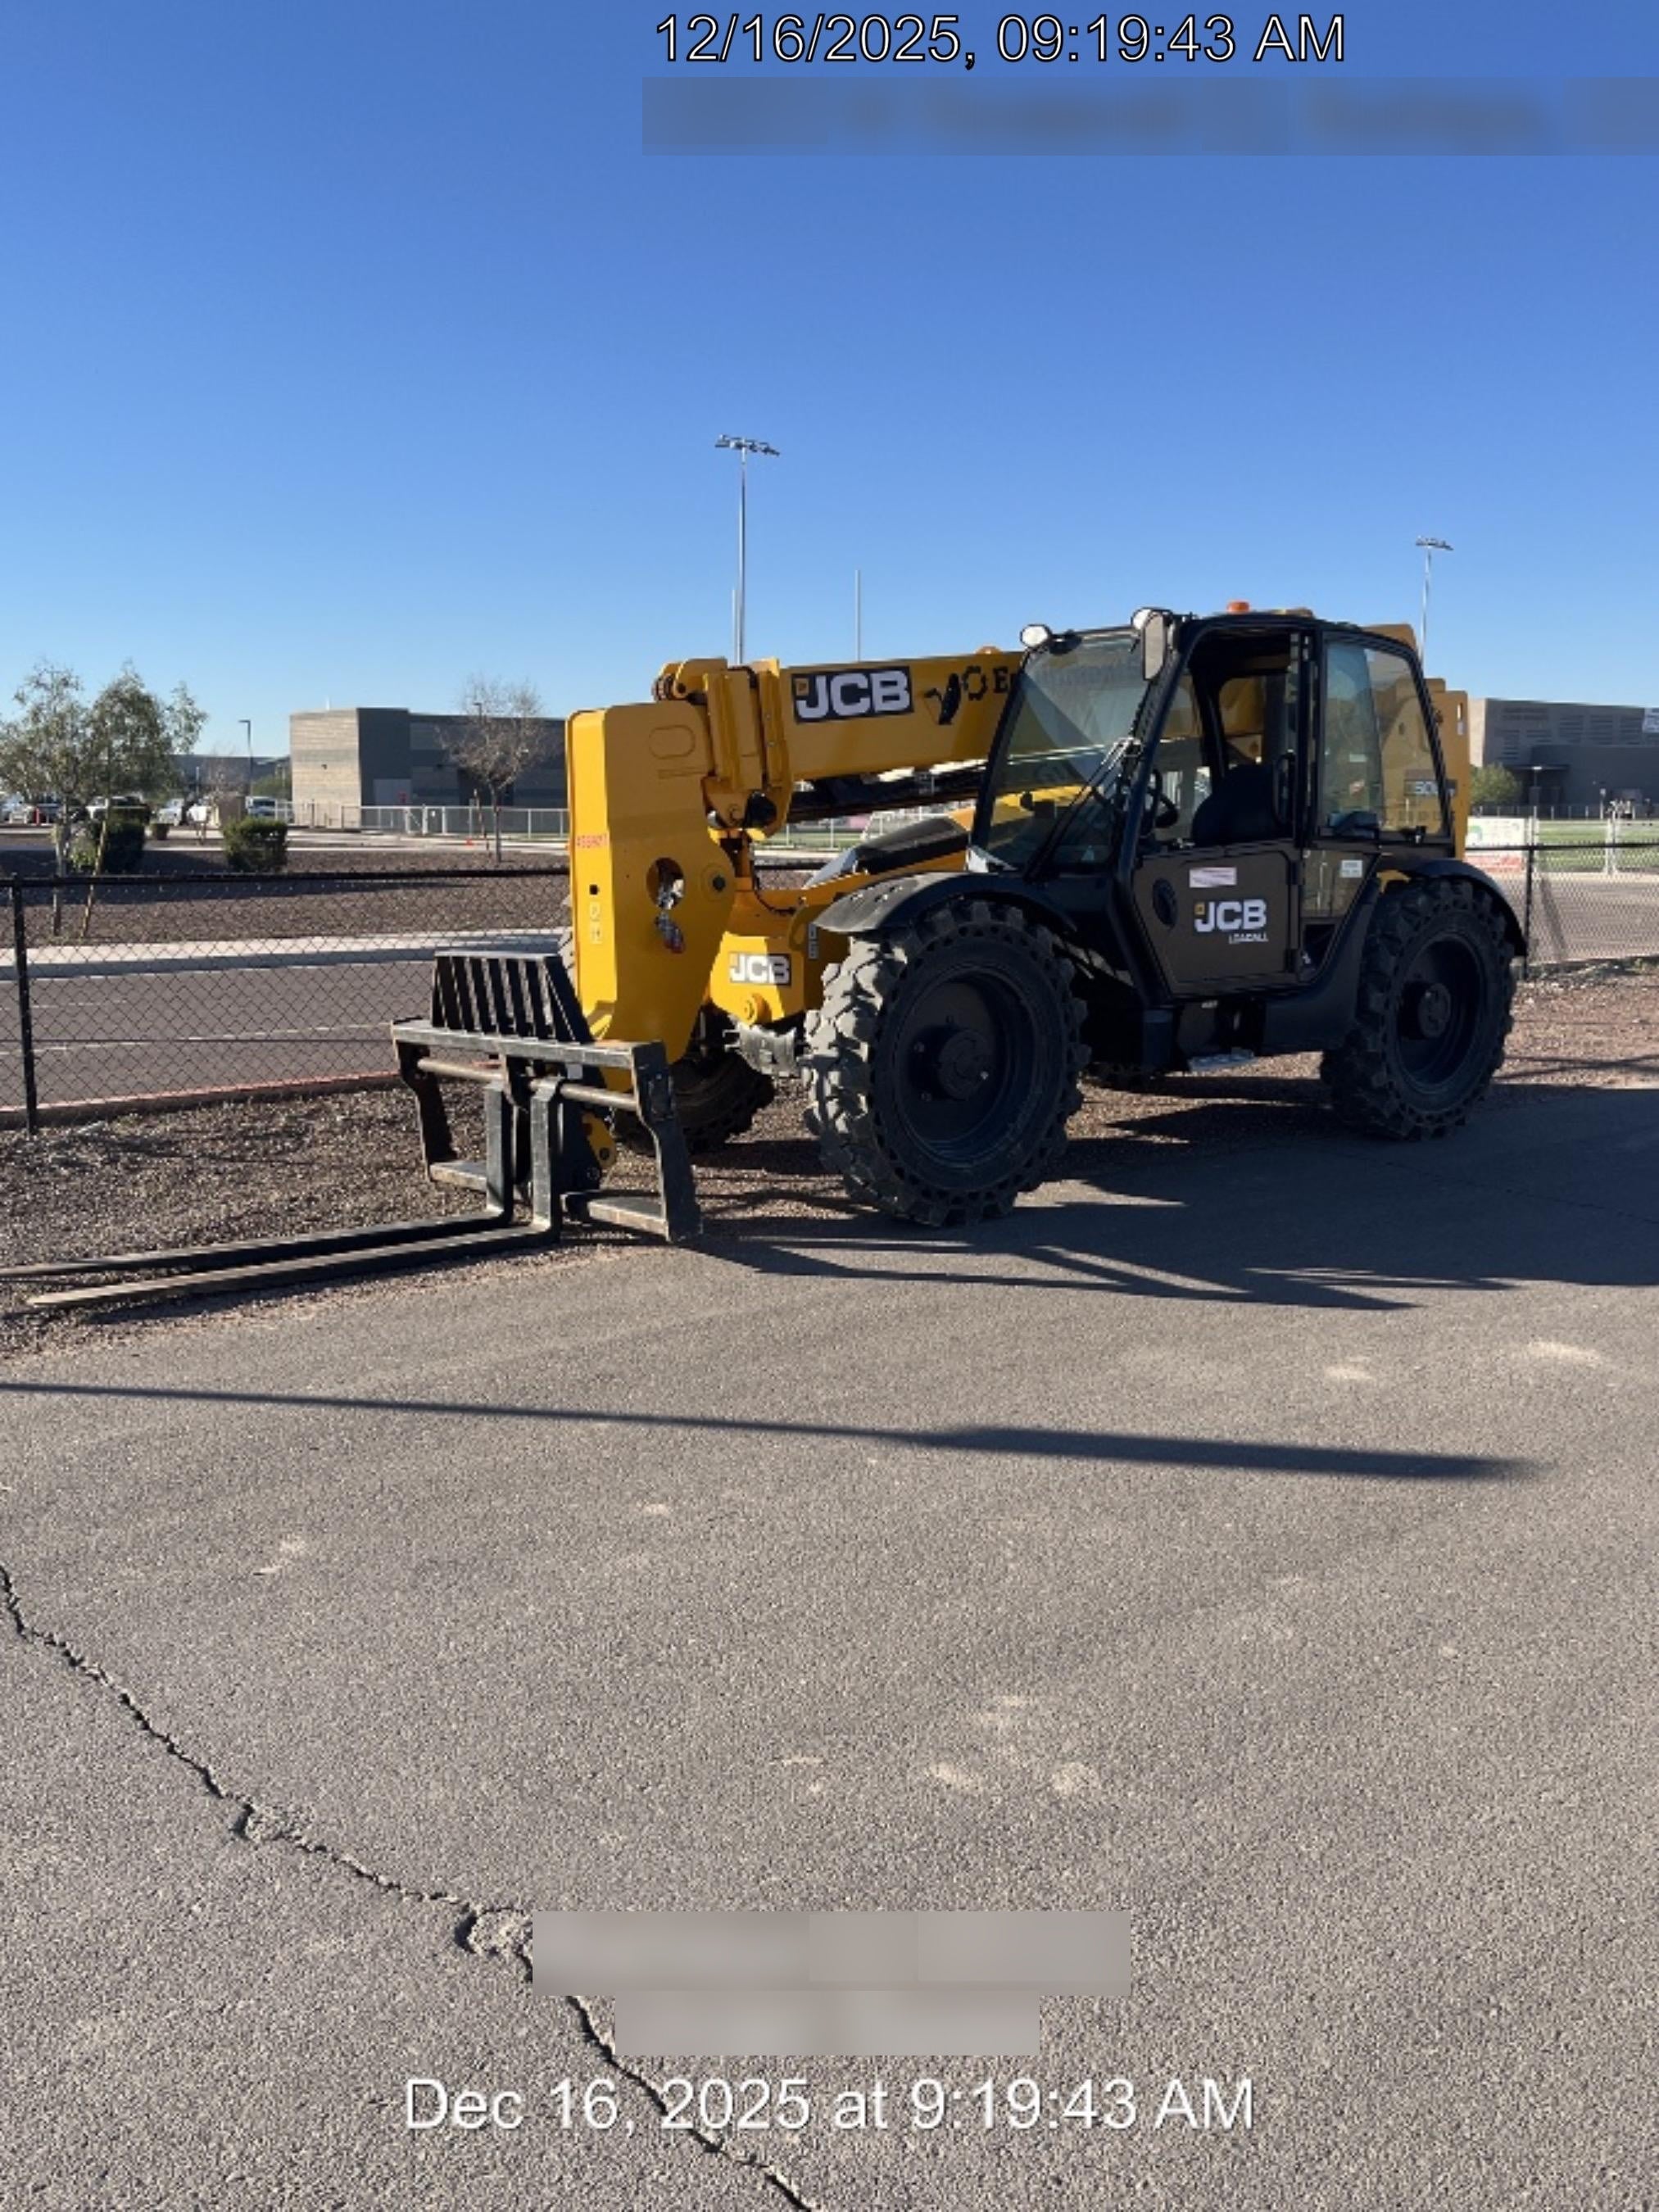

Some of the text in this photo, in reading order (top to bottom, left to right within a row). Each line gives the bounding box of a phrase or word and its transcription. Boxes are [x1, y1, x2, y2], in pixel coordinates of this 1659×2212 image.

[795, 669, 912, 719] JCB
[1194, 899, 1267, 932] JCB
[728, 953, 791, 984] JCB
